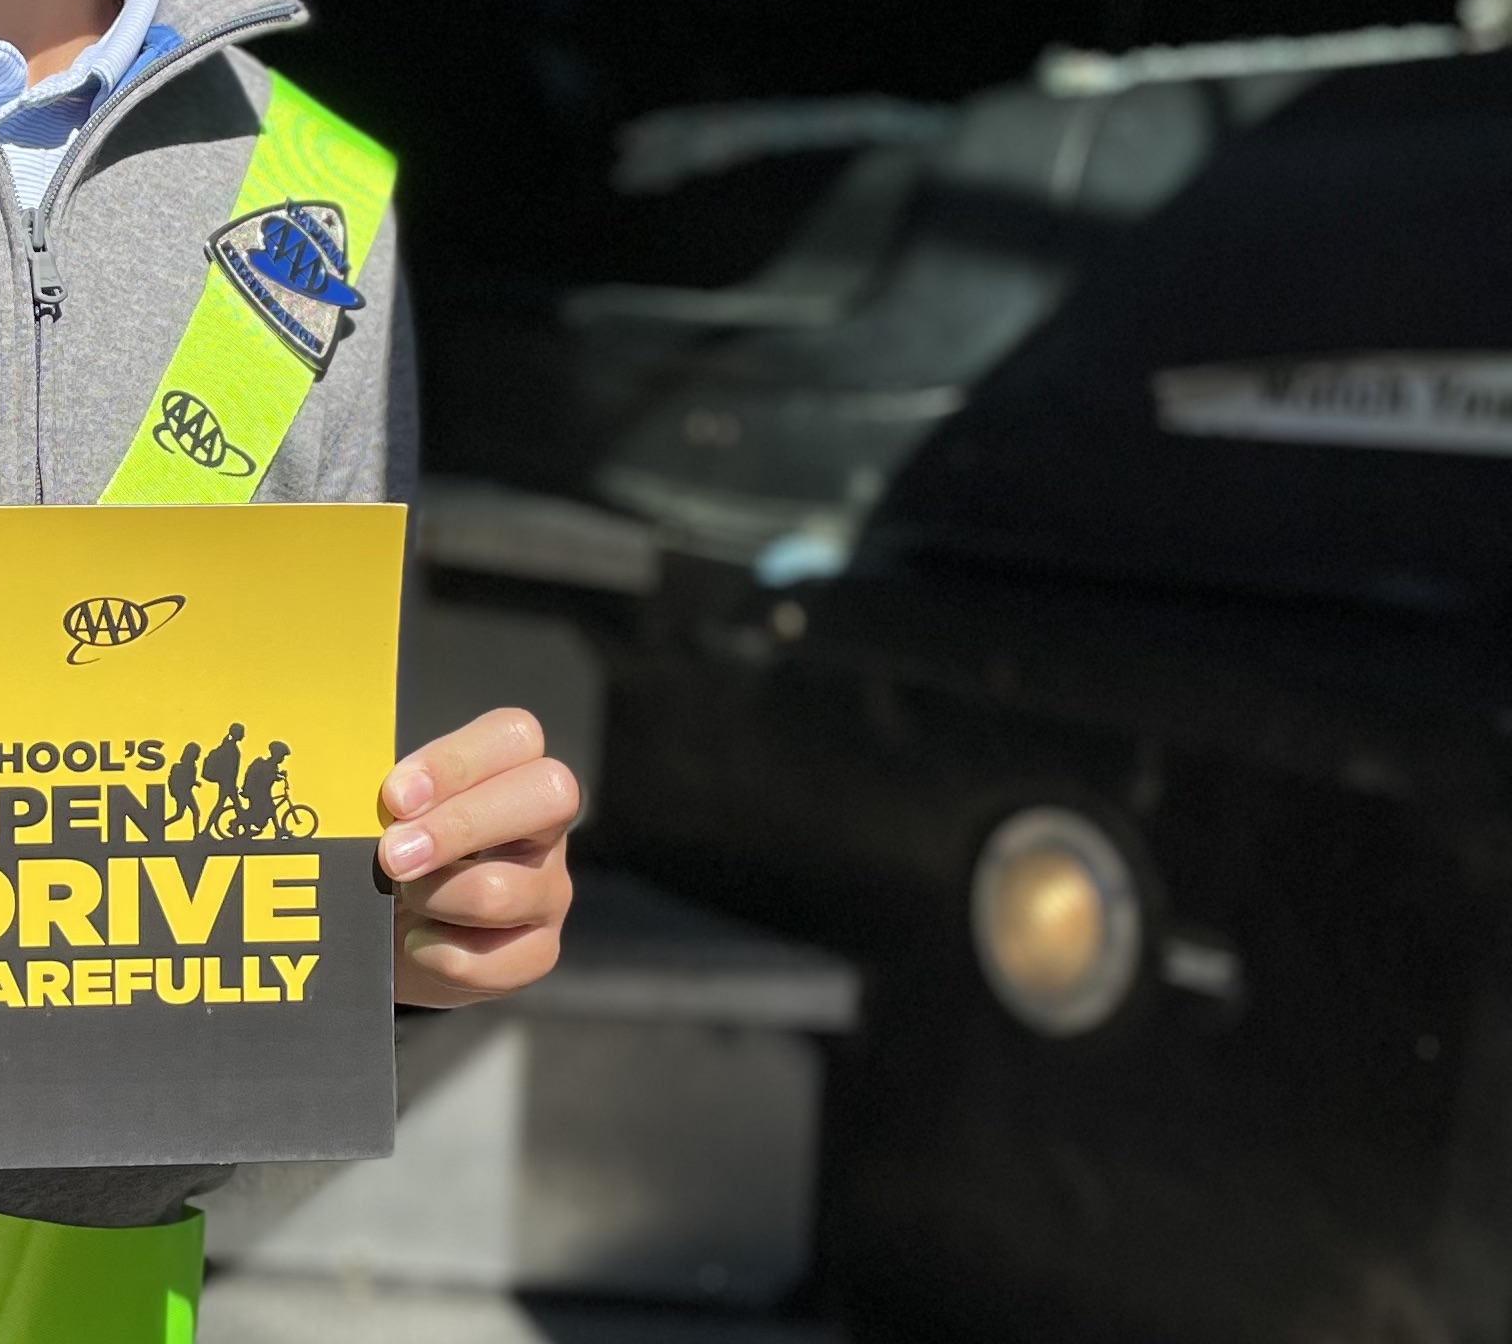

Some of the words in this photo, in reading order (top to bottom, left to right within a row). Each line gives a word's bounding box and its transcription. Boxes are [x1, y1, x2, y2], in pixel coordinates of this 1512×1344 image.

[269, 301, 319, 352] PATROL
[163, 391, 225, 466] AAA
[65, 597, 148, 646] AAA
